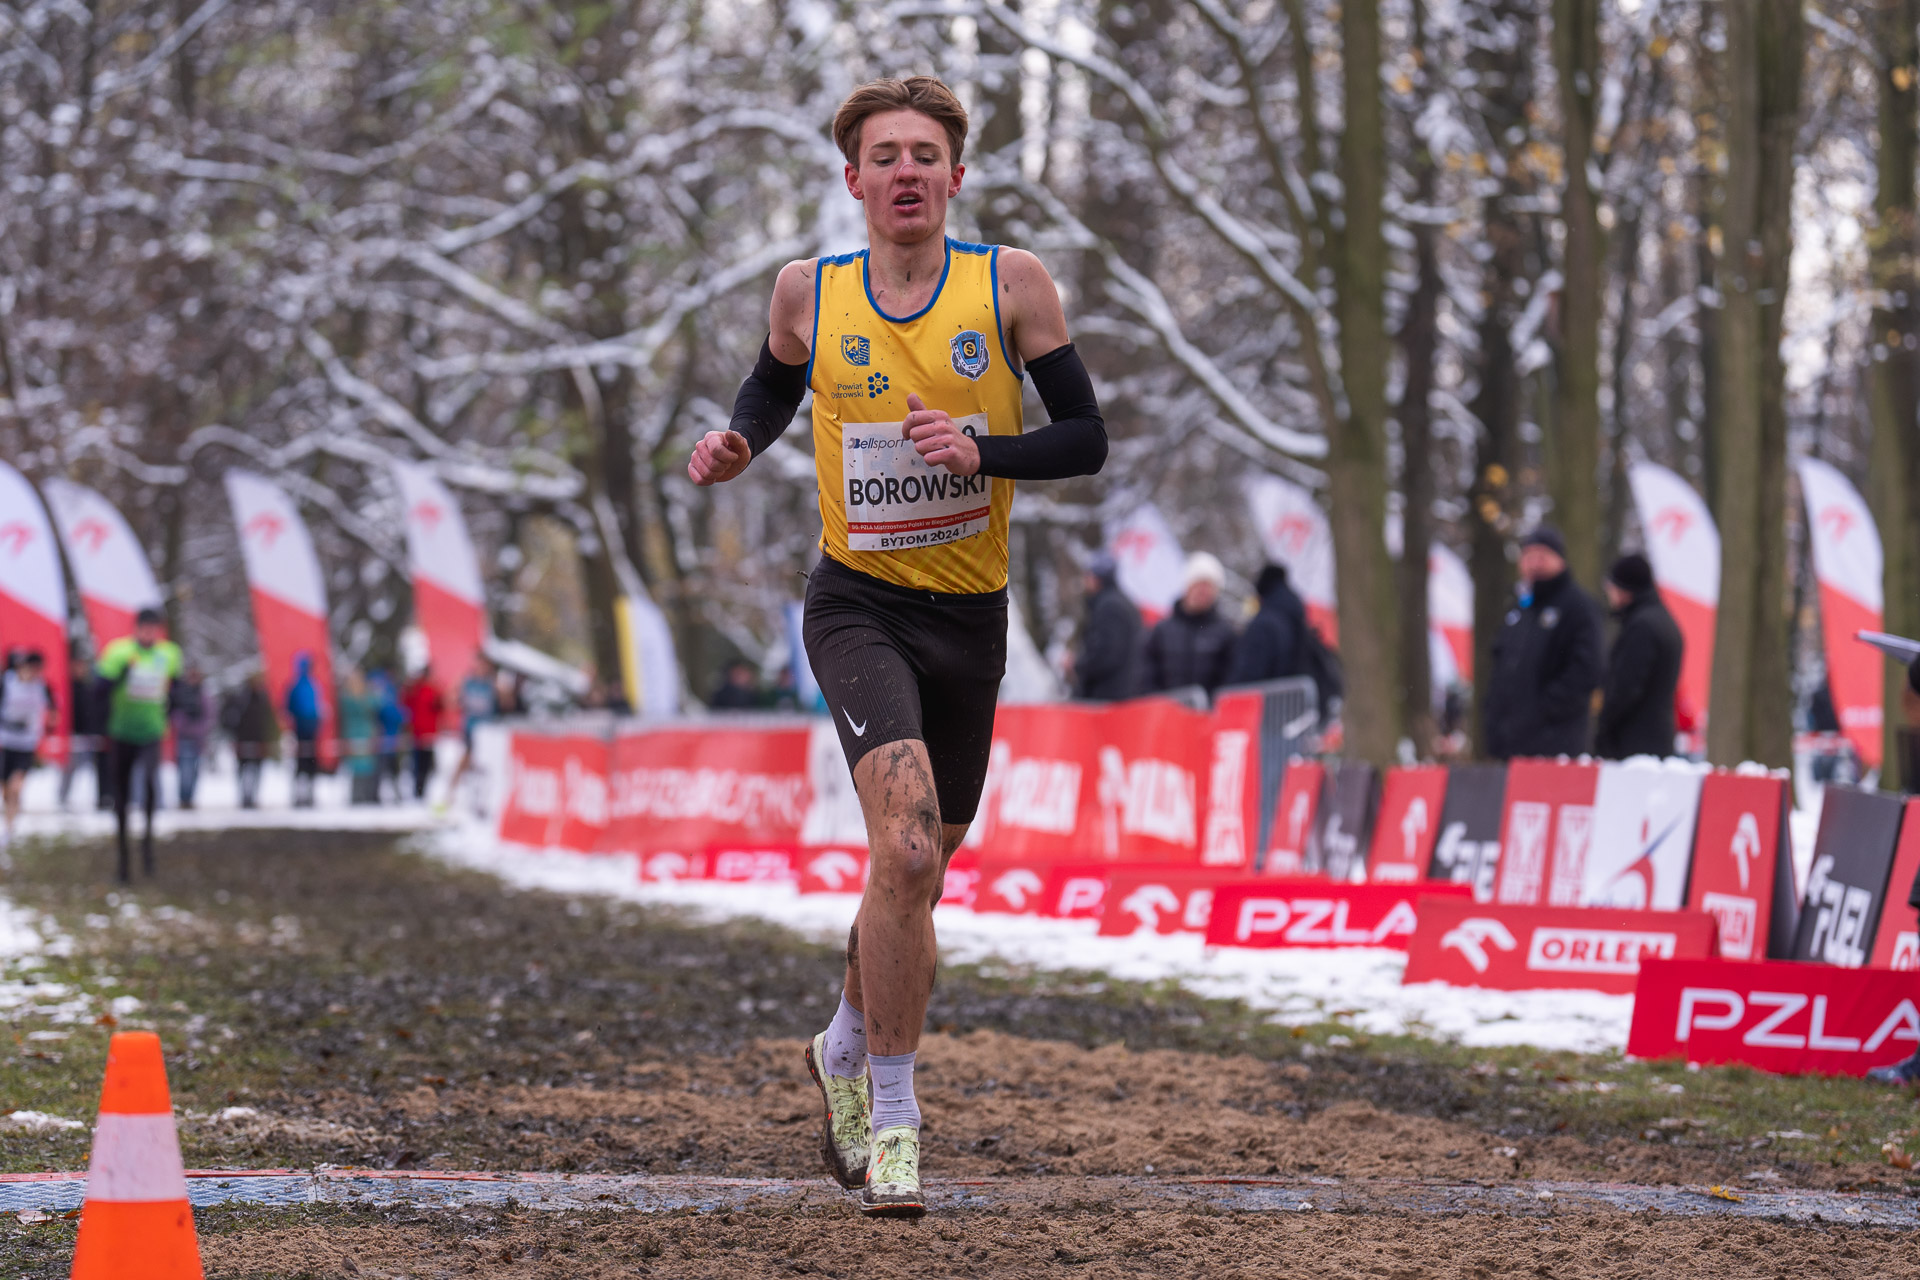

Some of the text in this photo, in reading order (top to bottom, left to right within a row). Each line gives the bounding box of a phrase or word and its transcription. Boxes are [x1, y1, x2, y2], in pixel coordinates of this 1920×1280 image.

[966, 343, 974, 355] S
[831, 390, 864, 399] Ostrowski
[837, 383, 863, 391] Powiat
[853, 437, 905, 451] Bellsport
[848, 473, 985, 506] BOROWSKI
[908, 520, 924, 528] Polski
[881, 533, 927, 547] BYTOM
[930, 528, 959, 541] 2024
[1236, 898, 1418, 943] PZLA
[1541, 938, 1662, 964] ORLEN
[1675, 986, 1920, 1053] PZLA
